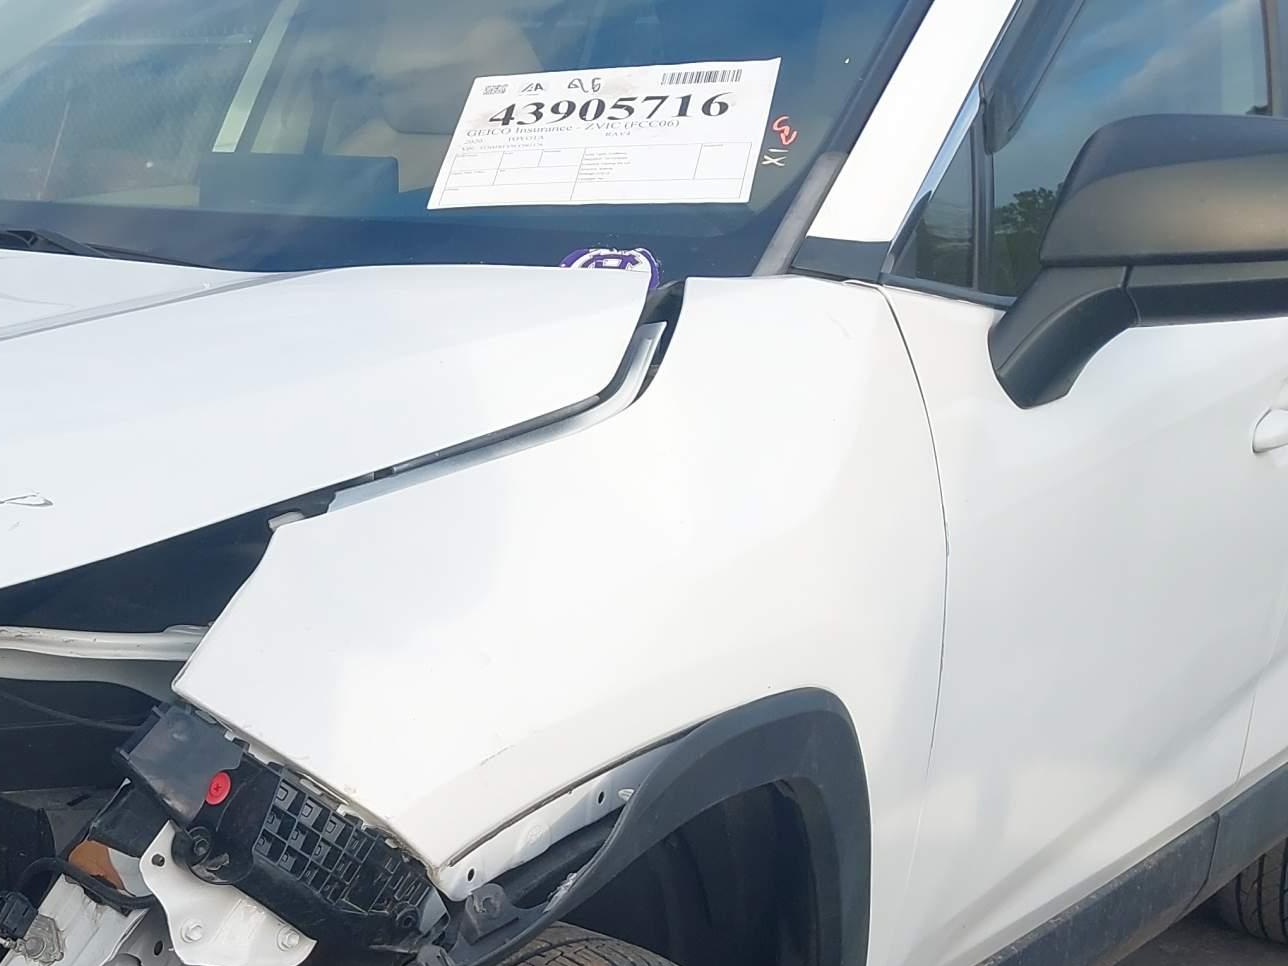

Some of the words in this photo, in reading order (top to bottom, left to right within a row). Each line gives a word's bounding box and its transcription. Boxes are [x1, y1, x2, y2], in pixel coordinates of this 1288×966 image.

[488, 91, 735, 126] 43905716
[466, 127, 512, 137] GEICO
[515, 124, 573, 134] Insurance
[585, 120, 621, 130] ZVIC
